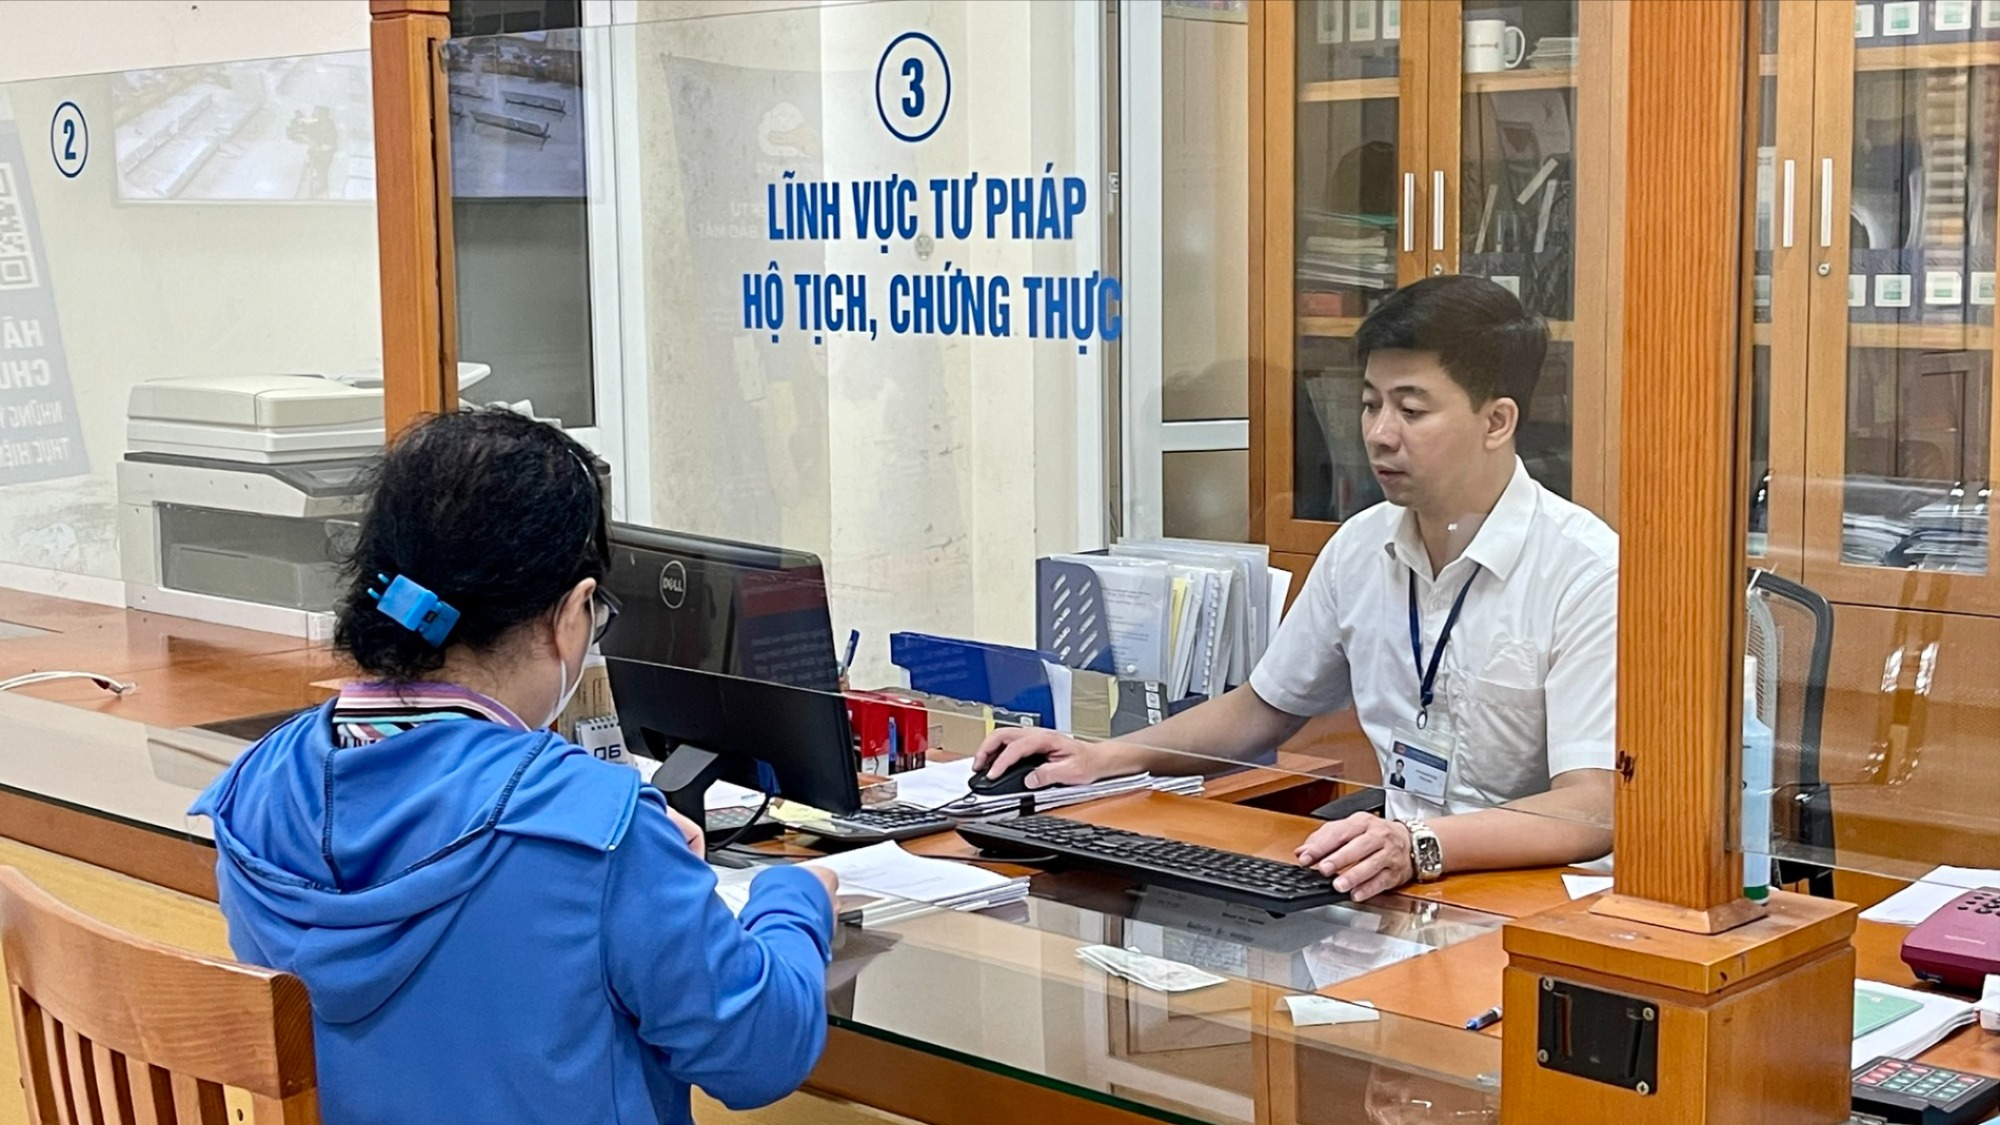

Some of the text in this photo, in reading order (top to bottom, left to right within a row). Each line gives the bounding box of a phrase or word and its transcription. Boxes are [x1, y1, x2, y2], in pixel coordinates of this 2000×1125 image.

[901, 57, 925, 118] 3
[63, 118, 77, 160] 2
[767, 162, 1087, 254] LĨNH VỰC TƯ PHÁP
[742, 261, 1123, 355] HỘ TỊCH, CHỨNG THỰC
[663, 577, 684, 592] DELL
[594, 744, 621, 760] 06
